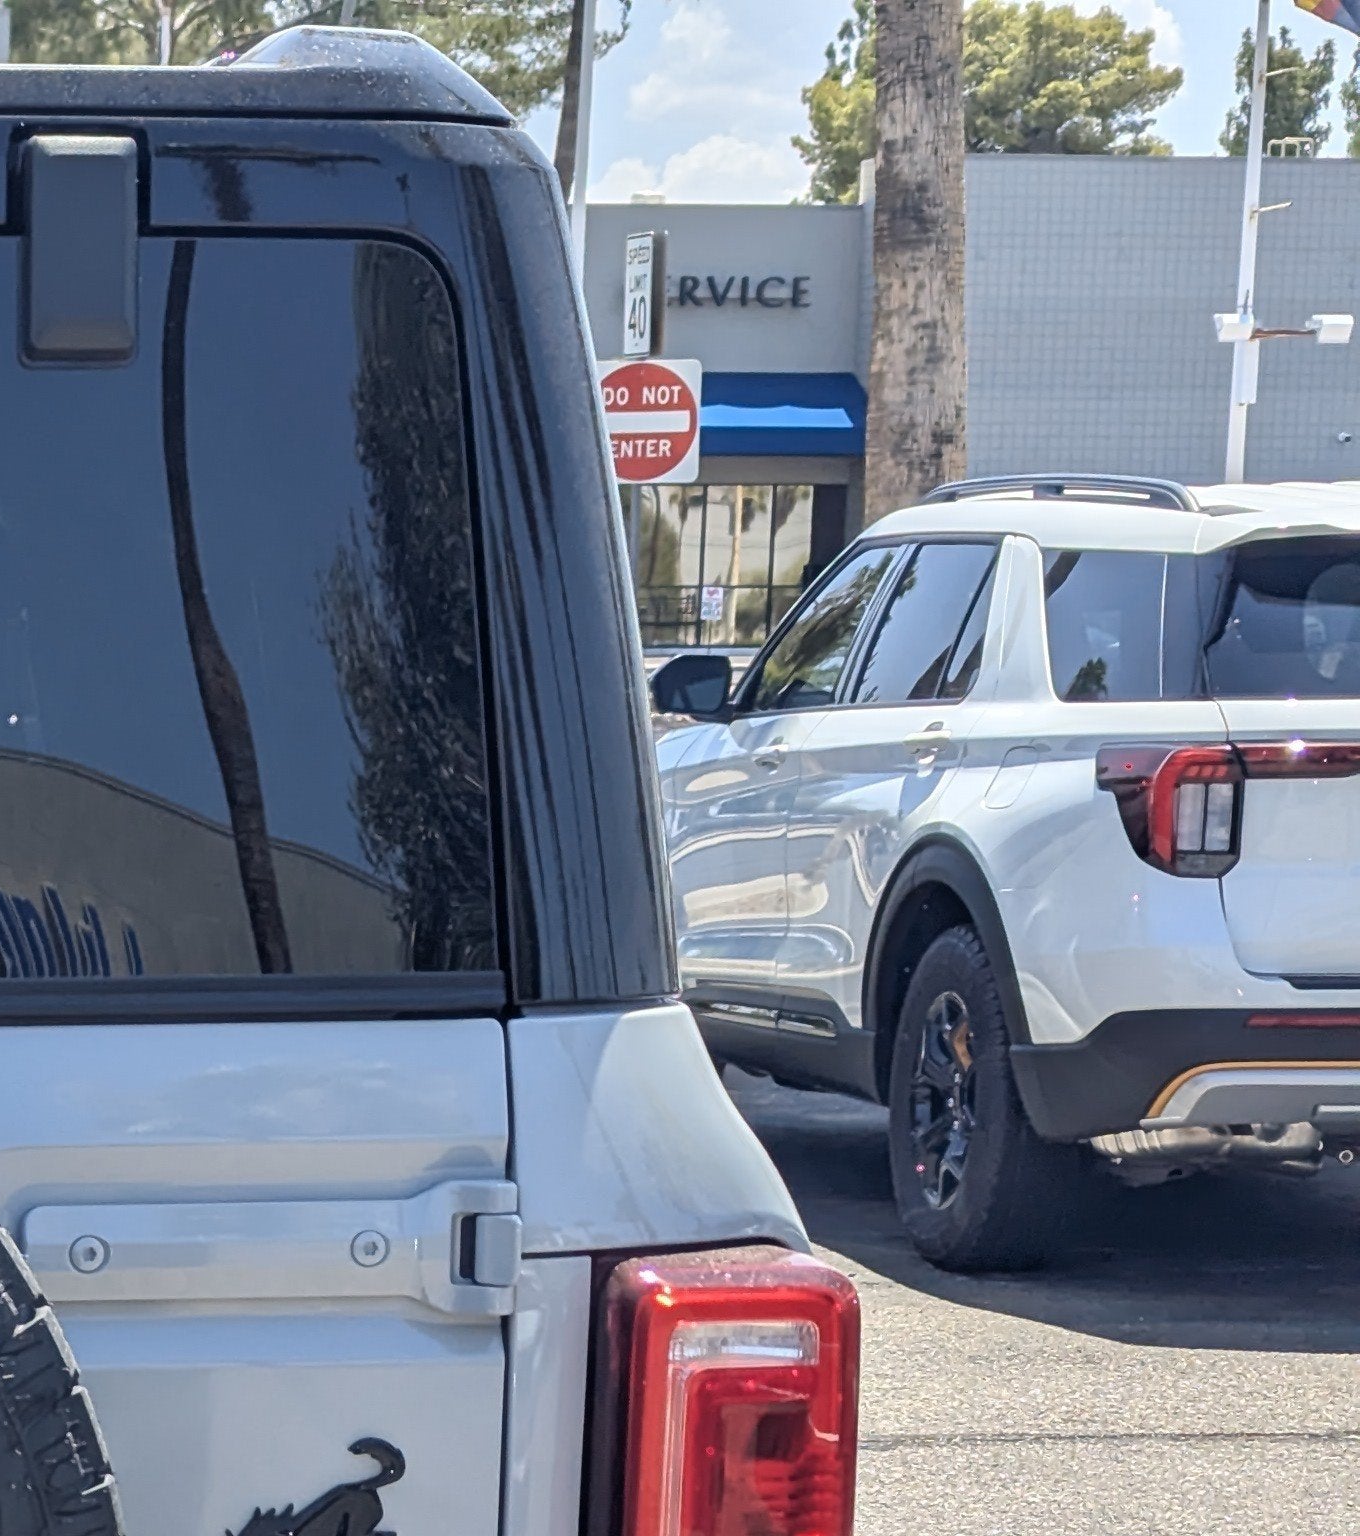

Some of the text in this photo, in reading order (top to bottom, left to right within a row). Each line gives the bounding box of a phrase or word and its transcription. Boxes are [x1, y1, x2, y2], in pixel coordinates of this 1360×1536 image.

[627, 245, 651, 264] SPEED
[629, 272, 649, 293] LIMIT
[667, 274, 811, 309] RVICE
[627, 295, 647, 340] 40
[603, 385, 682, 406] DO NOT
